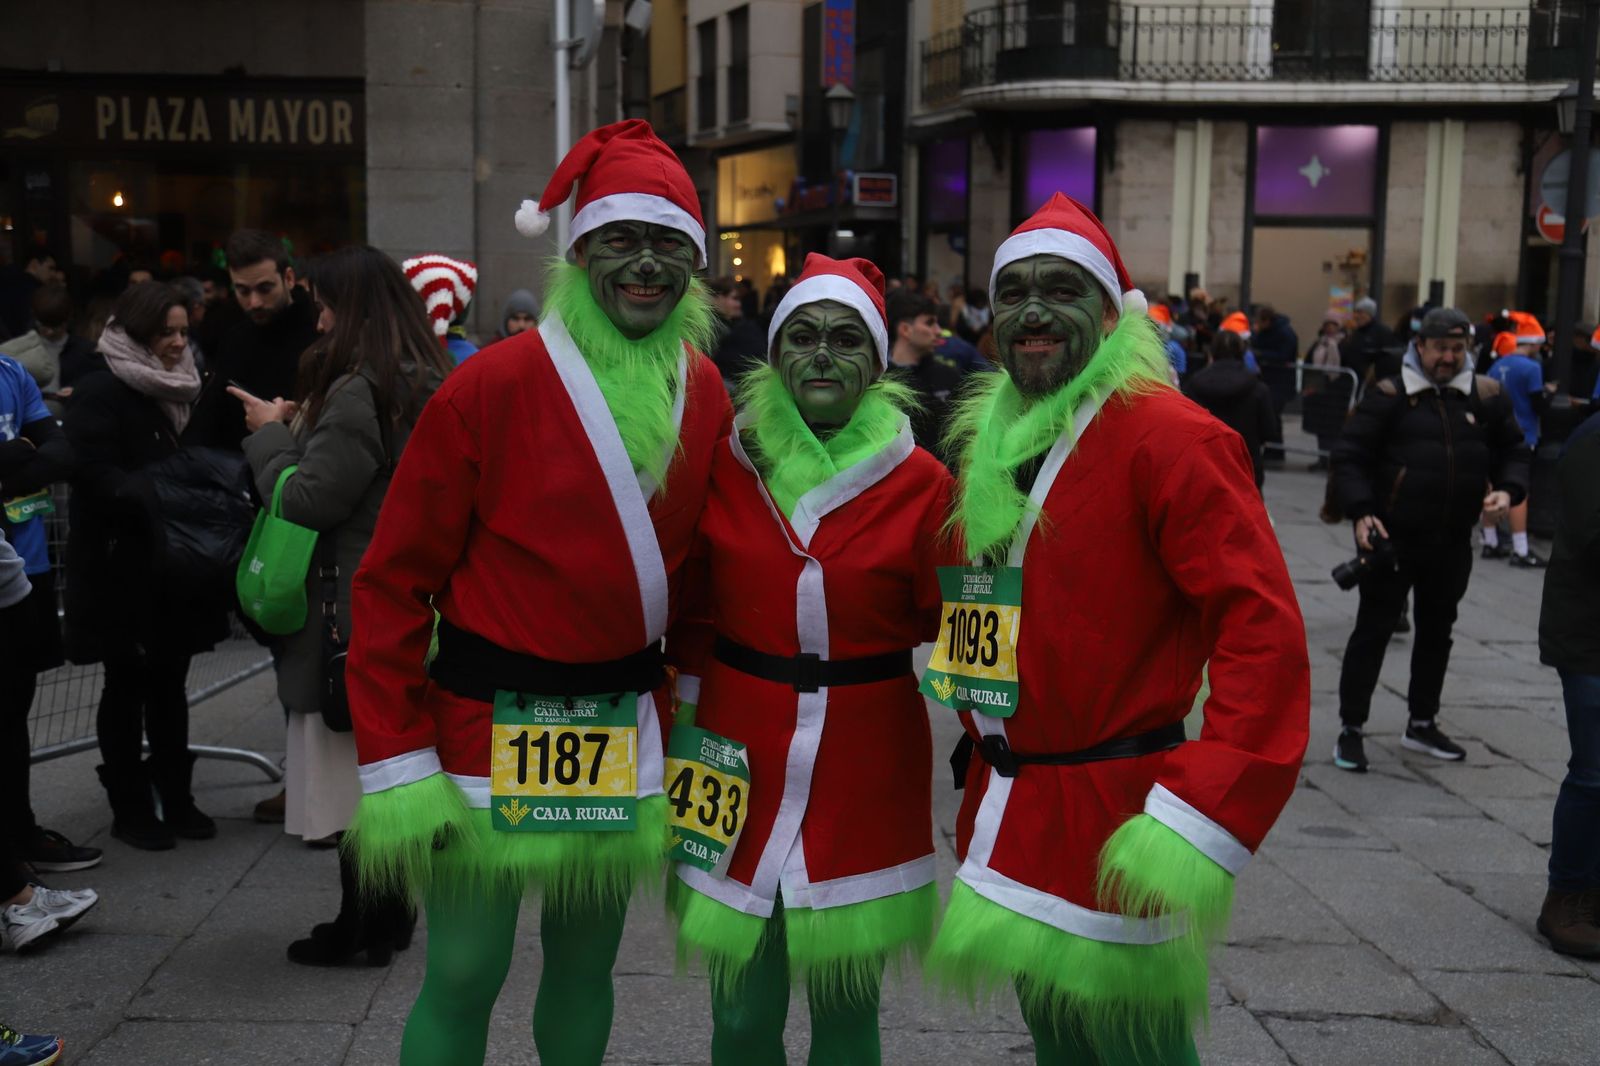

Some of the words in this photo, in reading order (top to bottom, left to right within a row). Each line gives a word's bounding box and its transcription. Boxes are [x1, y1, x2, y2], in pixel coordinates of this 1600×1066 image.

[96, 96, 212, 142] PLAZA
[229, 98, 354, 144] MAYOR
[947, 607, 999, 668] 1093
[534, 707, 560, 717] CAJA
[562, 708, 599, 718] RURAL
[970, 689, 1011, 707] RURAL
[508, 730, 610, 786] 1187
[532, 807, 573, 821] CAJA
[575, 807, 629, 821] RURAL
[668, 767, 741, 838] 433
[683, 839, 708, 860] CAJA
